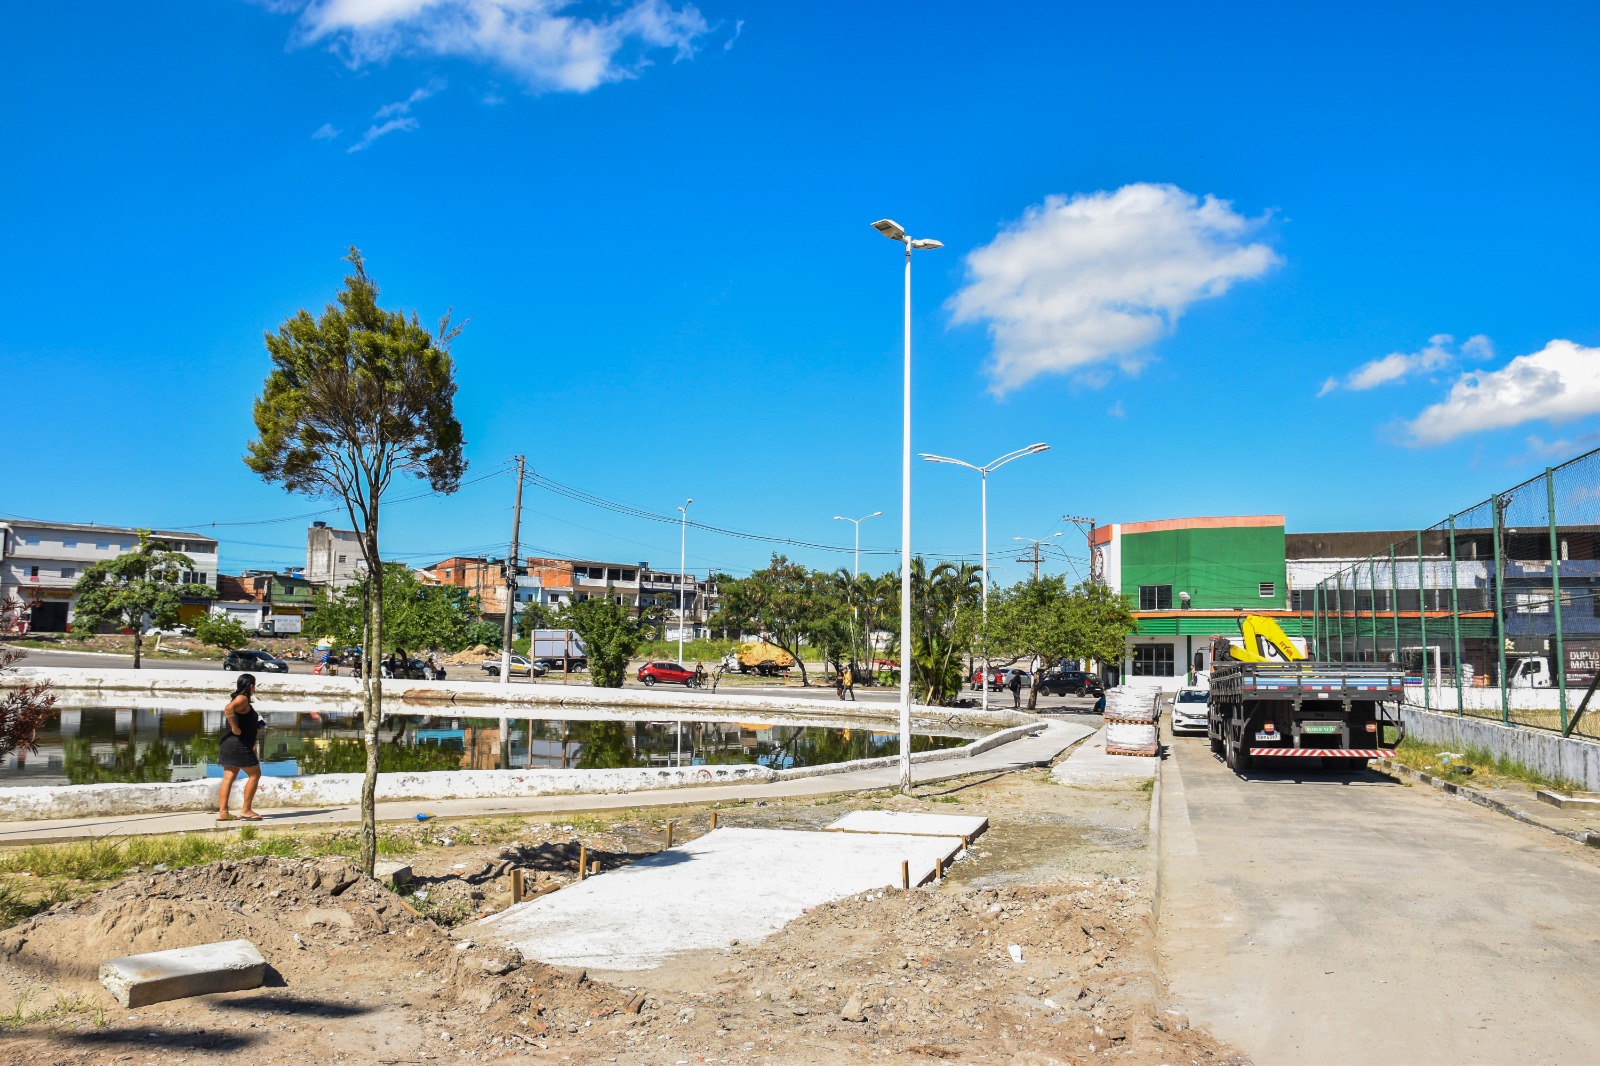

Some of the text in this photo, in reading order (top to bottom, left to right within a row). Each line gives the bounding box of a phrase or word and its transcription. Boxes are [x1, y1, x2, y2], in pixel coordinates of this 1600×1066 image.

[1279, 641, 1293, 657] HYVA
[1570, 651, 1600, 660] DUPLO
[1570, 660, 1600, 670] MALTE
